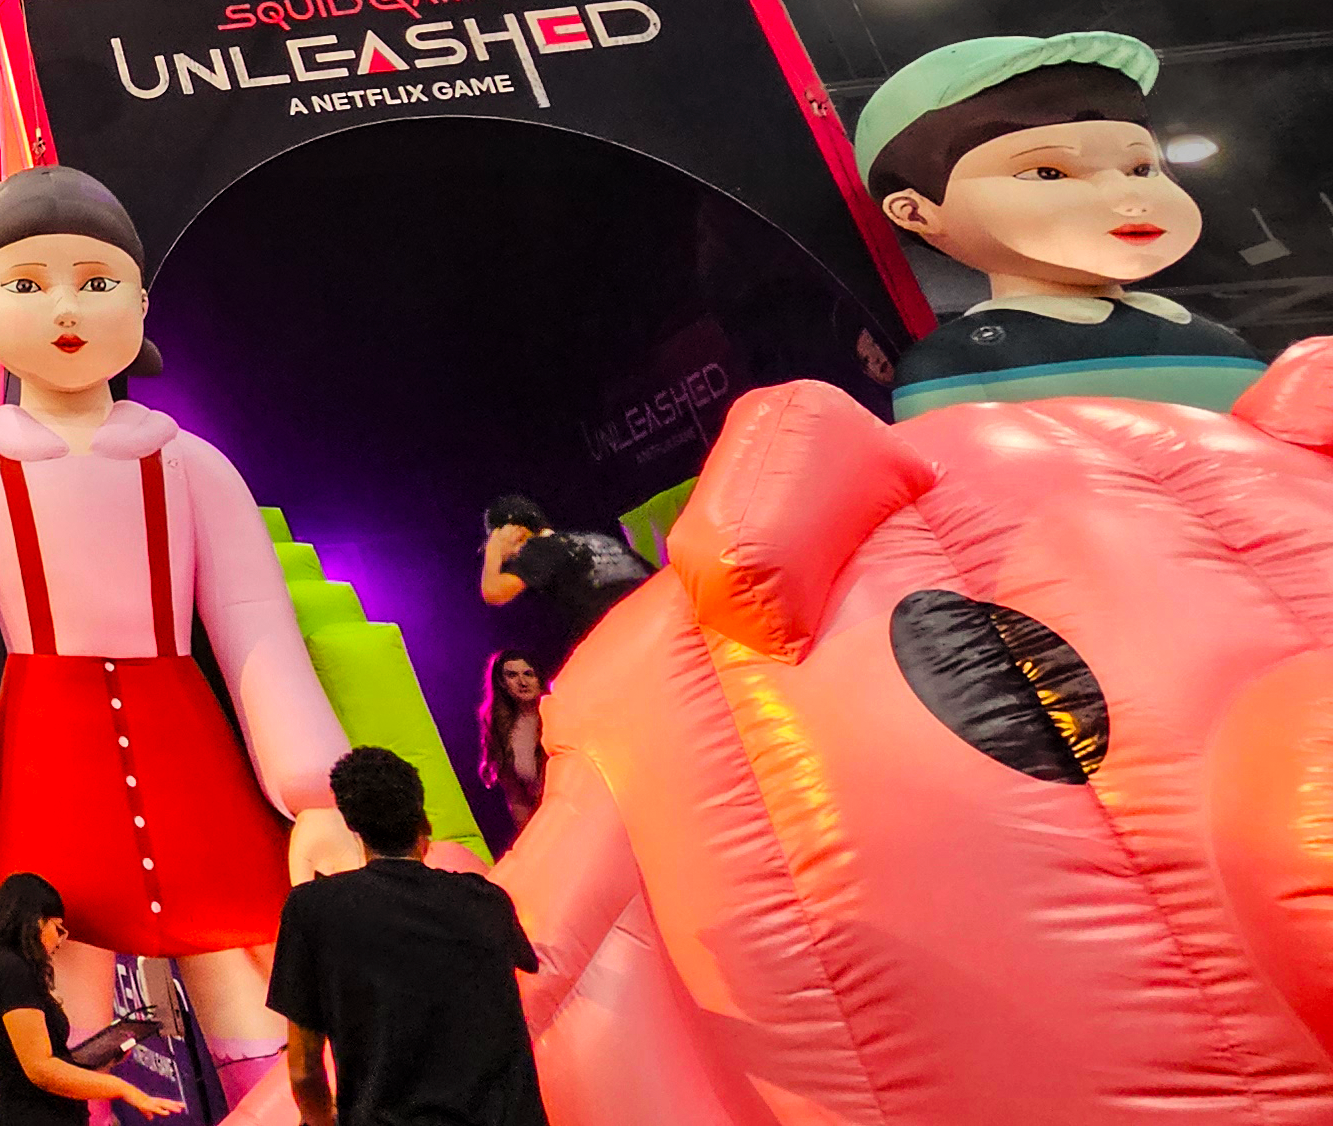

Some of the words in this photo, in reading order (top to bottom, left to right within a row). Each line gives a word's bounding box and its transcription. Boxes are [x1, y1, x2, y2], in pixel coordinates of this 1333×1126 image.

[110, 0, 661, 107] UNLEASHED
[288, 96, 308, 116] A
[312, 82, 429, 115] NETFLIX
[432, 73, 514, 102] GAME
